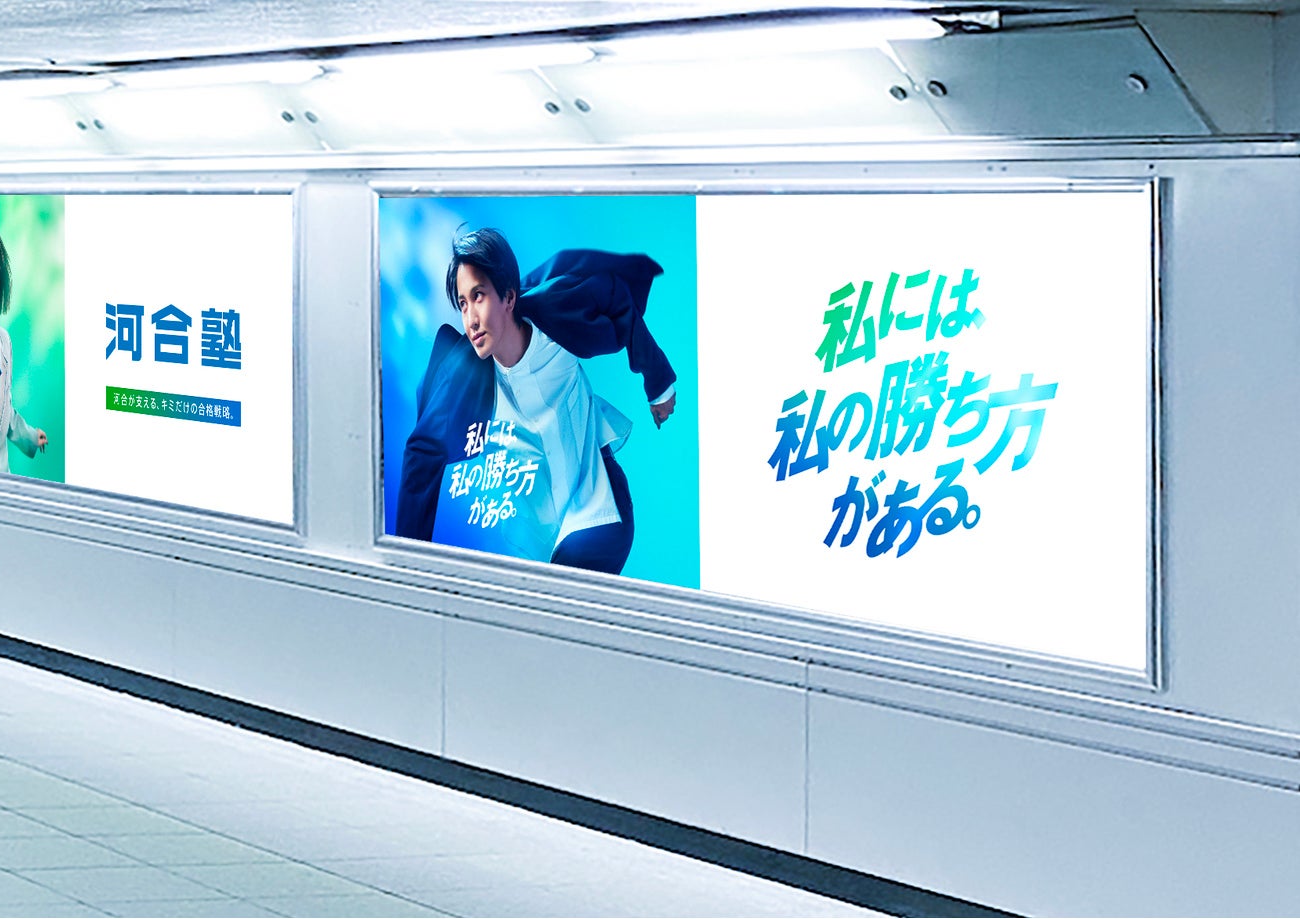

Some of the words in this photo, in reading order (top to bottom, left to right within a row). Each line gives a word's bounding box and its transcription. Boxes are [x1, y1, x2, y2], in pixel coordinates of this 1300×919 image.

[105, 302, 242, 370] 河合塾
[113, 392, 234, 420] 河合が支える、キミだけの合格戦略。
[767, 350, 1059, 482] 私の勝ち方
[448, 449, 540, 499] 私の勝ち方
[467, 491, 518, 529] がある。
[823, 457, 982, 559] がある。
